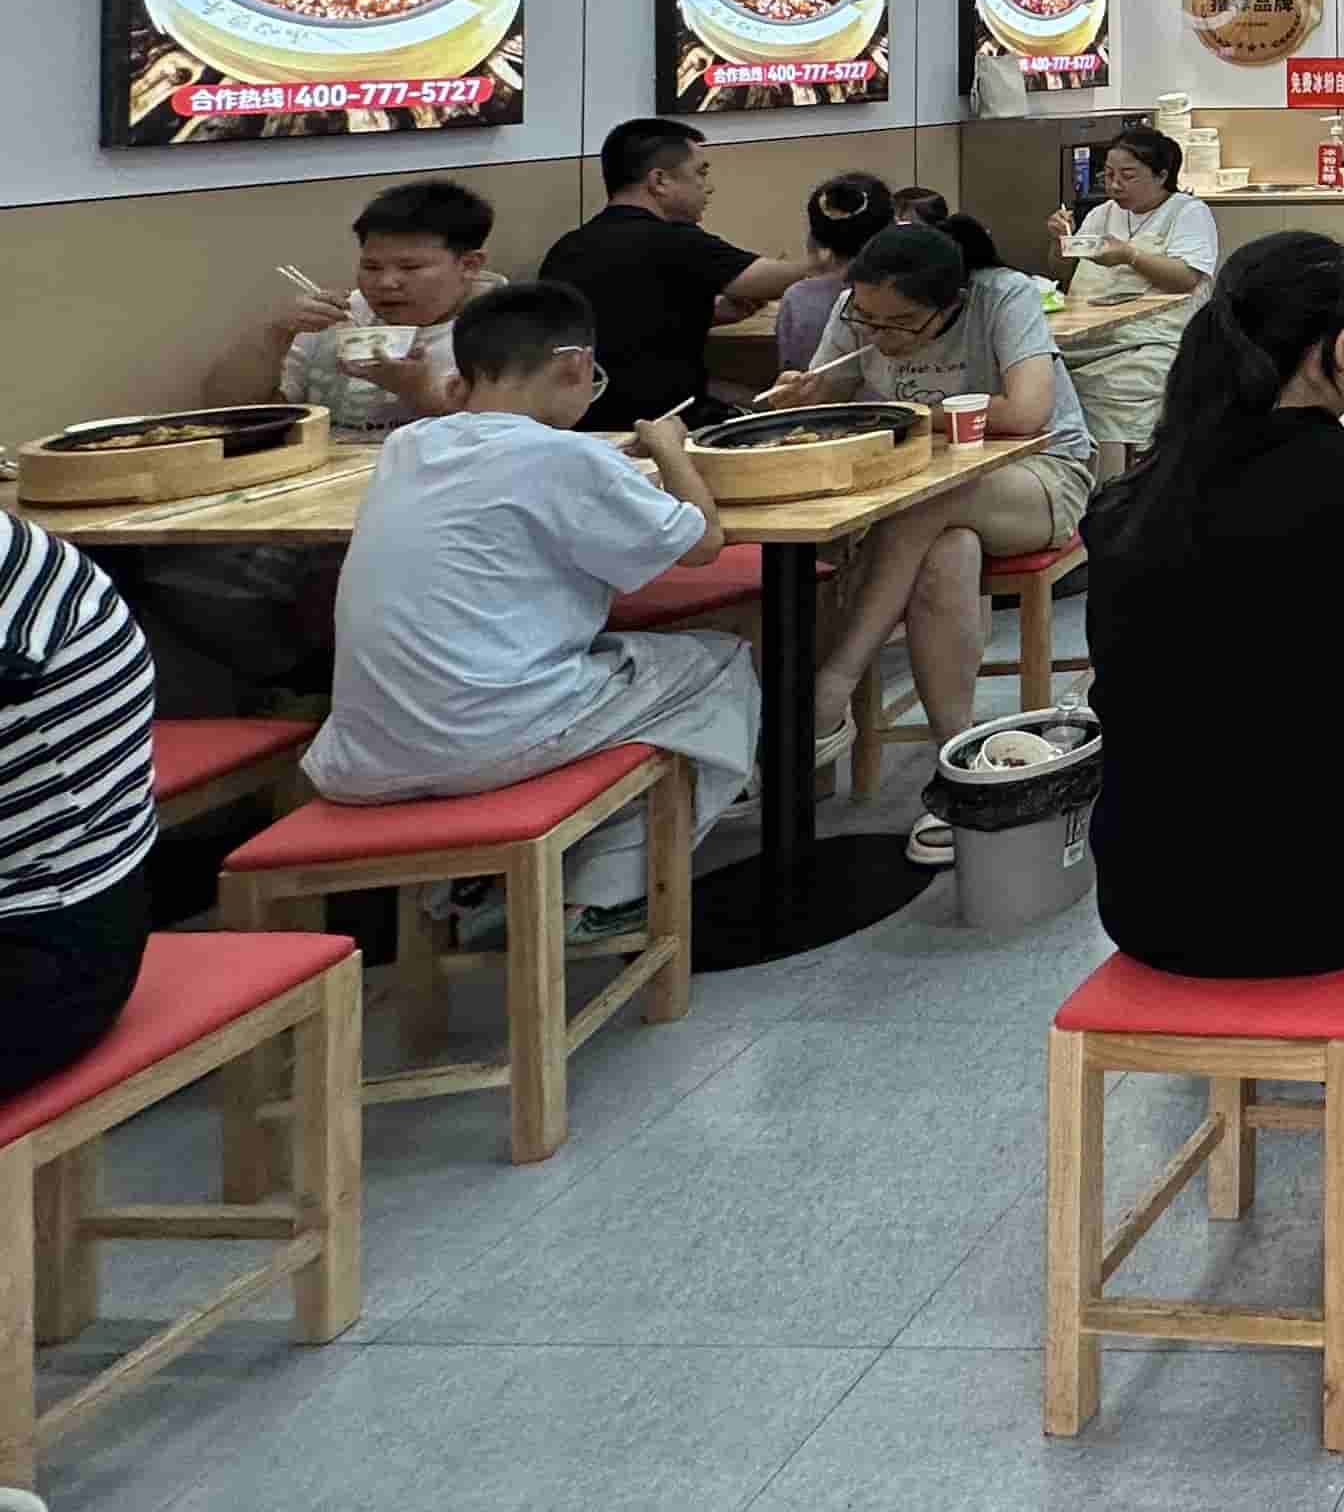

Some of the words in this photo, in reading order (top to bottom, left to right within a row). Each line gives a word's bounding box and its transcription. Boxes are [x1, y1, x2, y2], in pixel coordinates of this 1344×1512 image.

[767, 62, 867, 83] 400-777-5727
[190, 86, 287, 112] 合作热线
[295, 79, 481, 108] 400-777-5727
